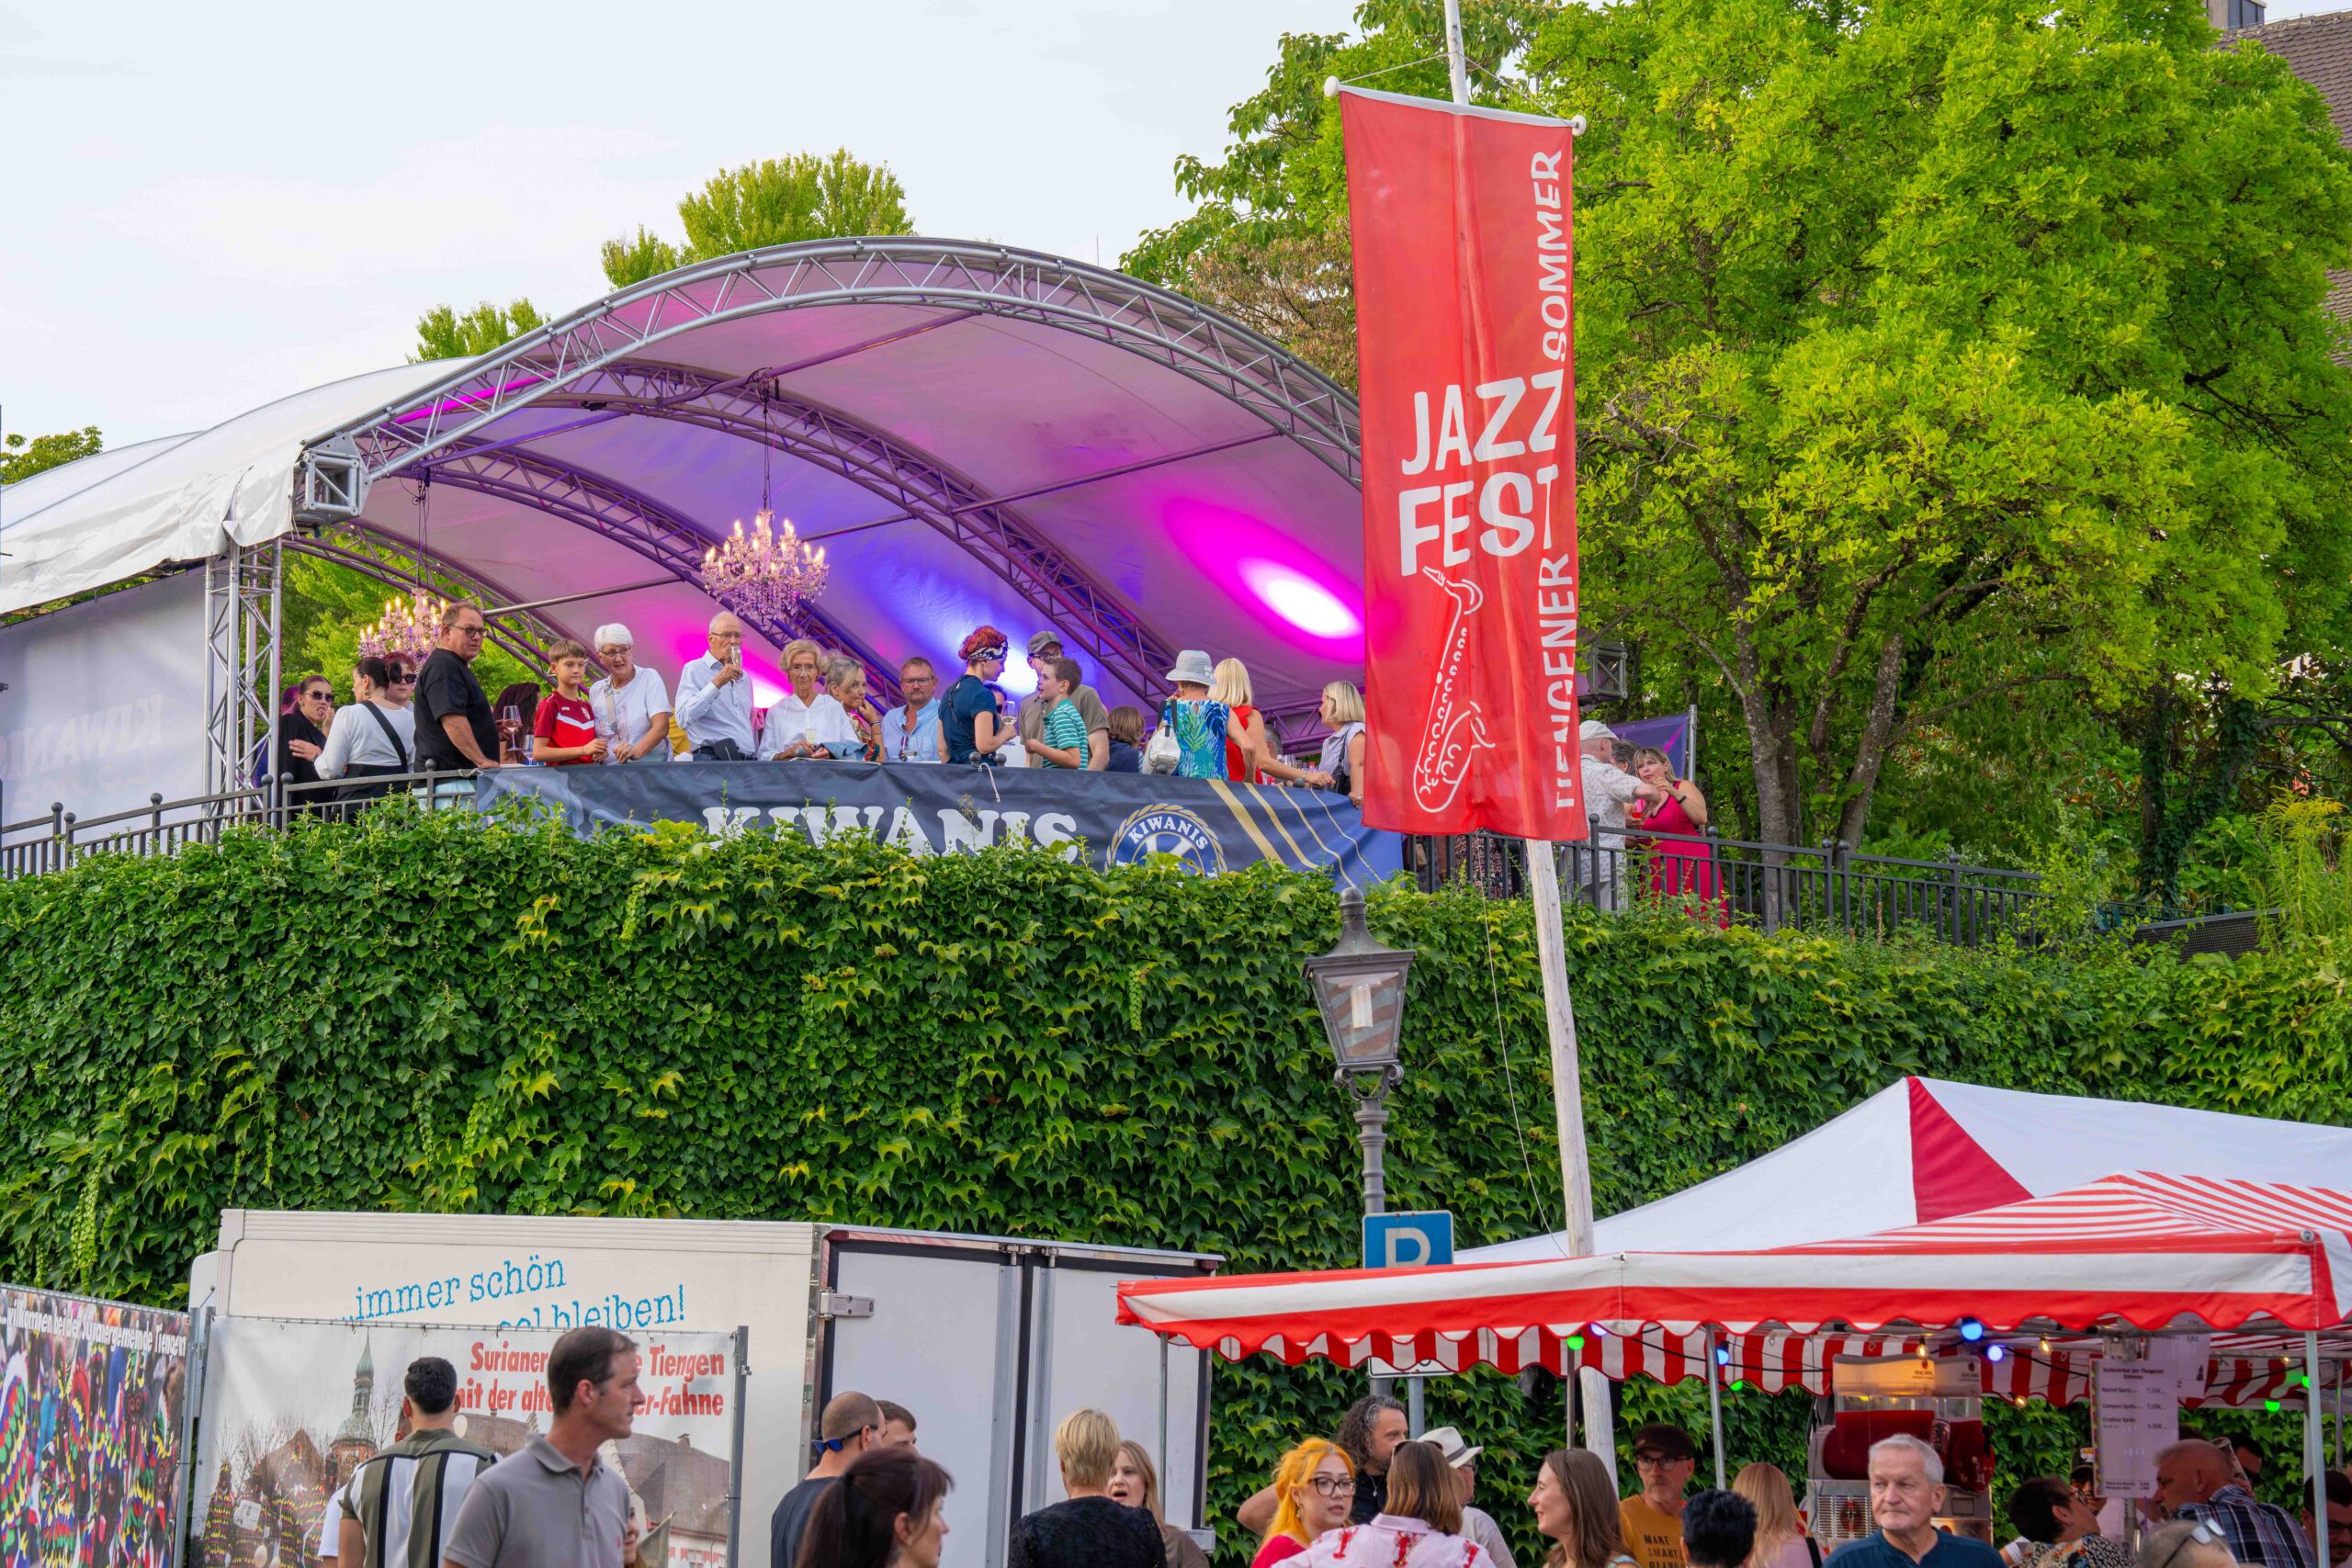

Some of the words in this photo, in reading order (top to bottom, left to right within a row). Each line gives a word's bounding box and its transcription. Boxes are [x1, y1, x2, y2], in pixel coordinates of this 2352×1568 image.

[1531, 150, 1567, 362] SOMMER
[1401, 368, 1564, 476] JAZZ
[1398, 463, 1559, 577] FEST
[702, 806, 1078, 864] KIWANIS
[1128, 816, 1208, 850] KIWANIS
[469, 1255, 566, 1301] schön
[551, 1283, 684, 1331] bleiben!
[154, 1322, 187, 1361] Tiengen
[649, 1344, 725, 1382] Tiengen
[488, 1378, 516, 1411] der
[1644, 1534, 1669, 1545] MAKE
[1647, 1548, 1678, 1559] SMART
